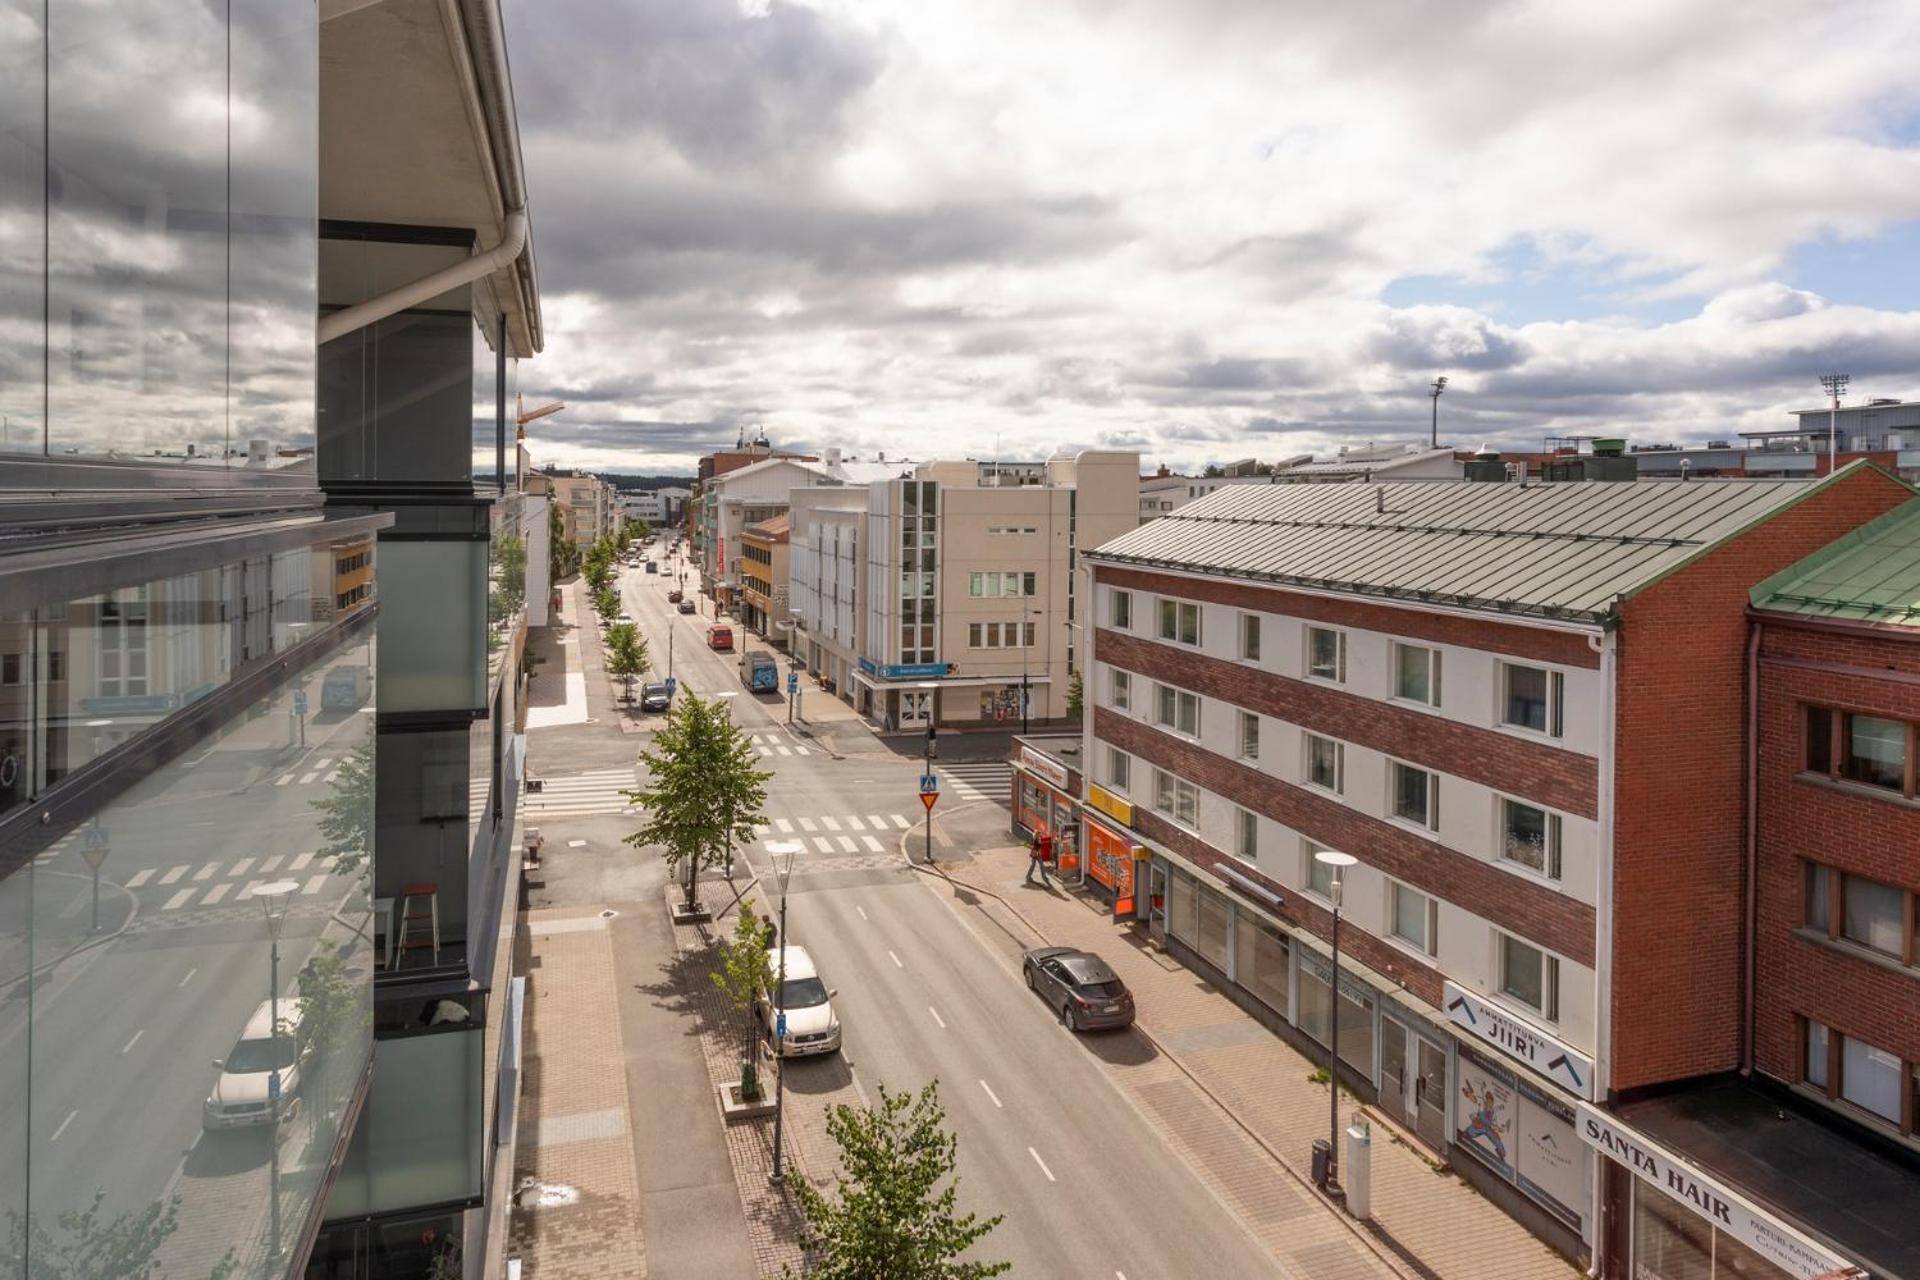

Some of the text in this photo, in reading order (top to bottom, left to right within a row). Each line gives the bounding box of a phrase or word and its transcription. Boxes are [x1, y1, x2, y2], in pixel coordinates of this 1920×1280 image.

[1479, 1007, 1545, 1048] AMMATTITURVA
[1488, 1023, 1535, 1061] JIIRI
[1586, 1119, 1659, 1179] SANTA
[1668, 1169, 1732, 1226] HAIR
